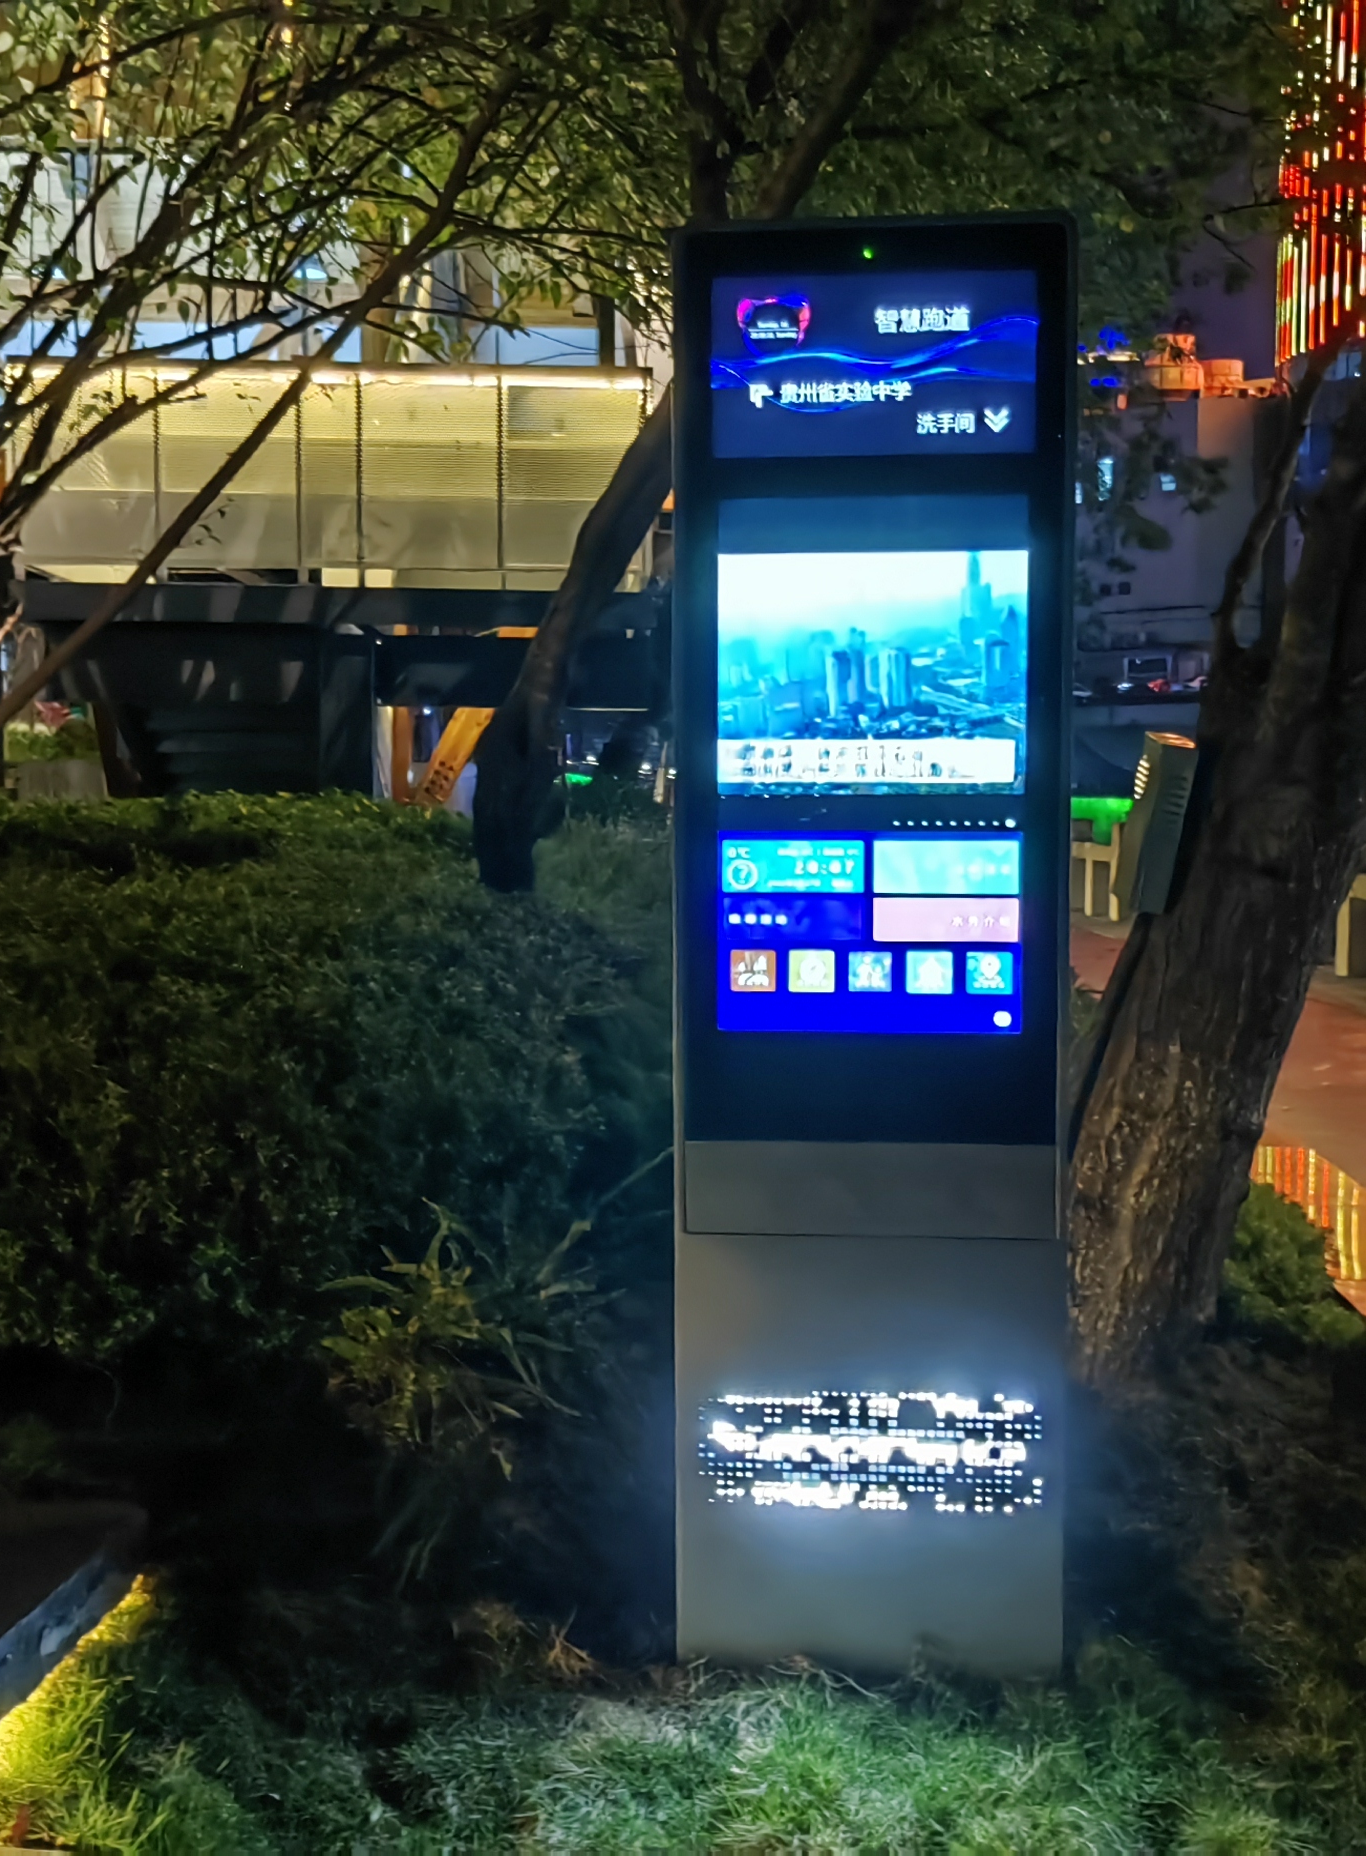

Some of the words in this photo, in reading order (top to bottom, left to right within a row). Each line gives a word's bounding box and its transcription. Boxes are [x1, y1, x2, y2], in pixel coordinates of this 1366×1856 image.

[875, 307, 970, 334] 智慧跑道
[779, 381, 912, 403] 贵州省实验中学
[916, 413, 976, 434] 洗手间
